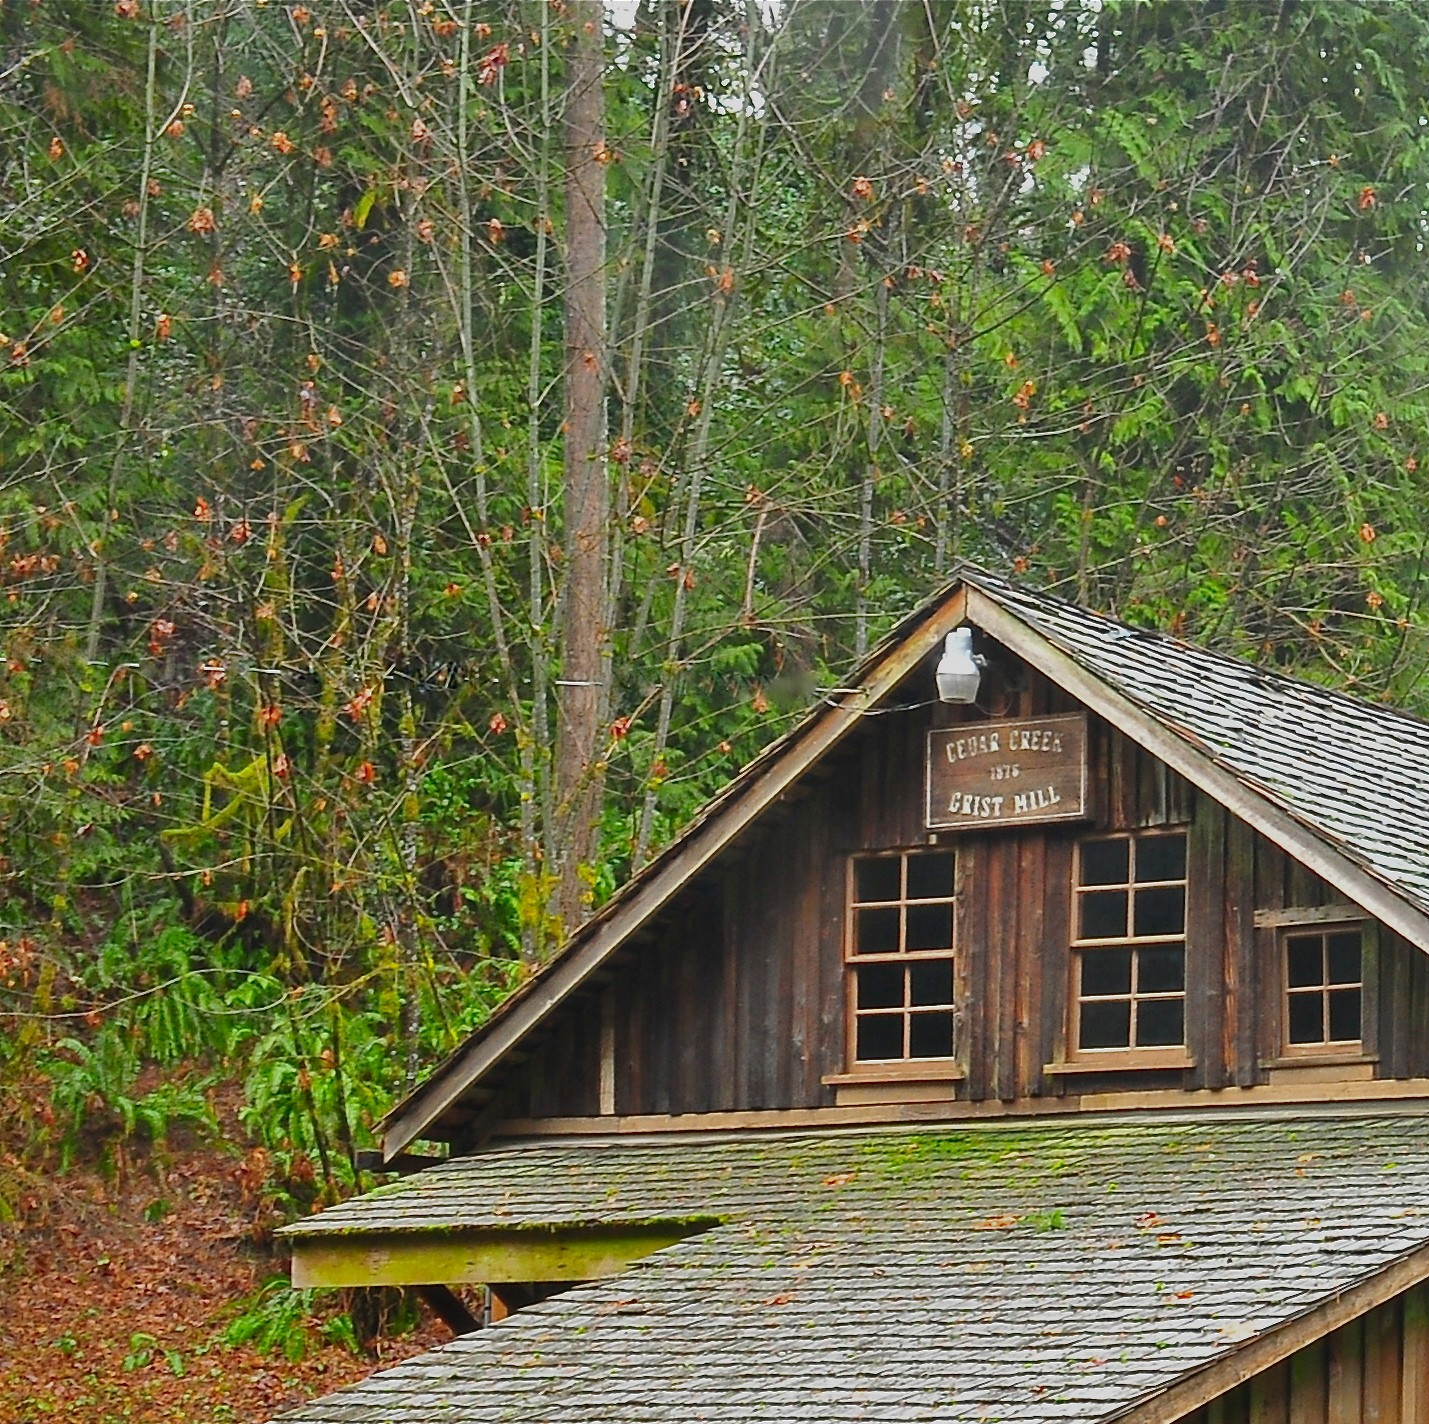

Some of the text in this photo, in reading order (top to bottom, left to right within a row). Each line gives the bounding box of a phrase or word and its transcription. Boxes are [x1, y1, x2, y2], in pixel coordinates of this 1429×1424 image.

[946, 730, 1064, 763] CEDAR CREEK
[948, 785, 1061, 818] GRIST MILL
